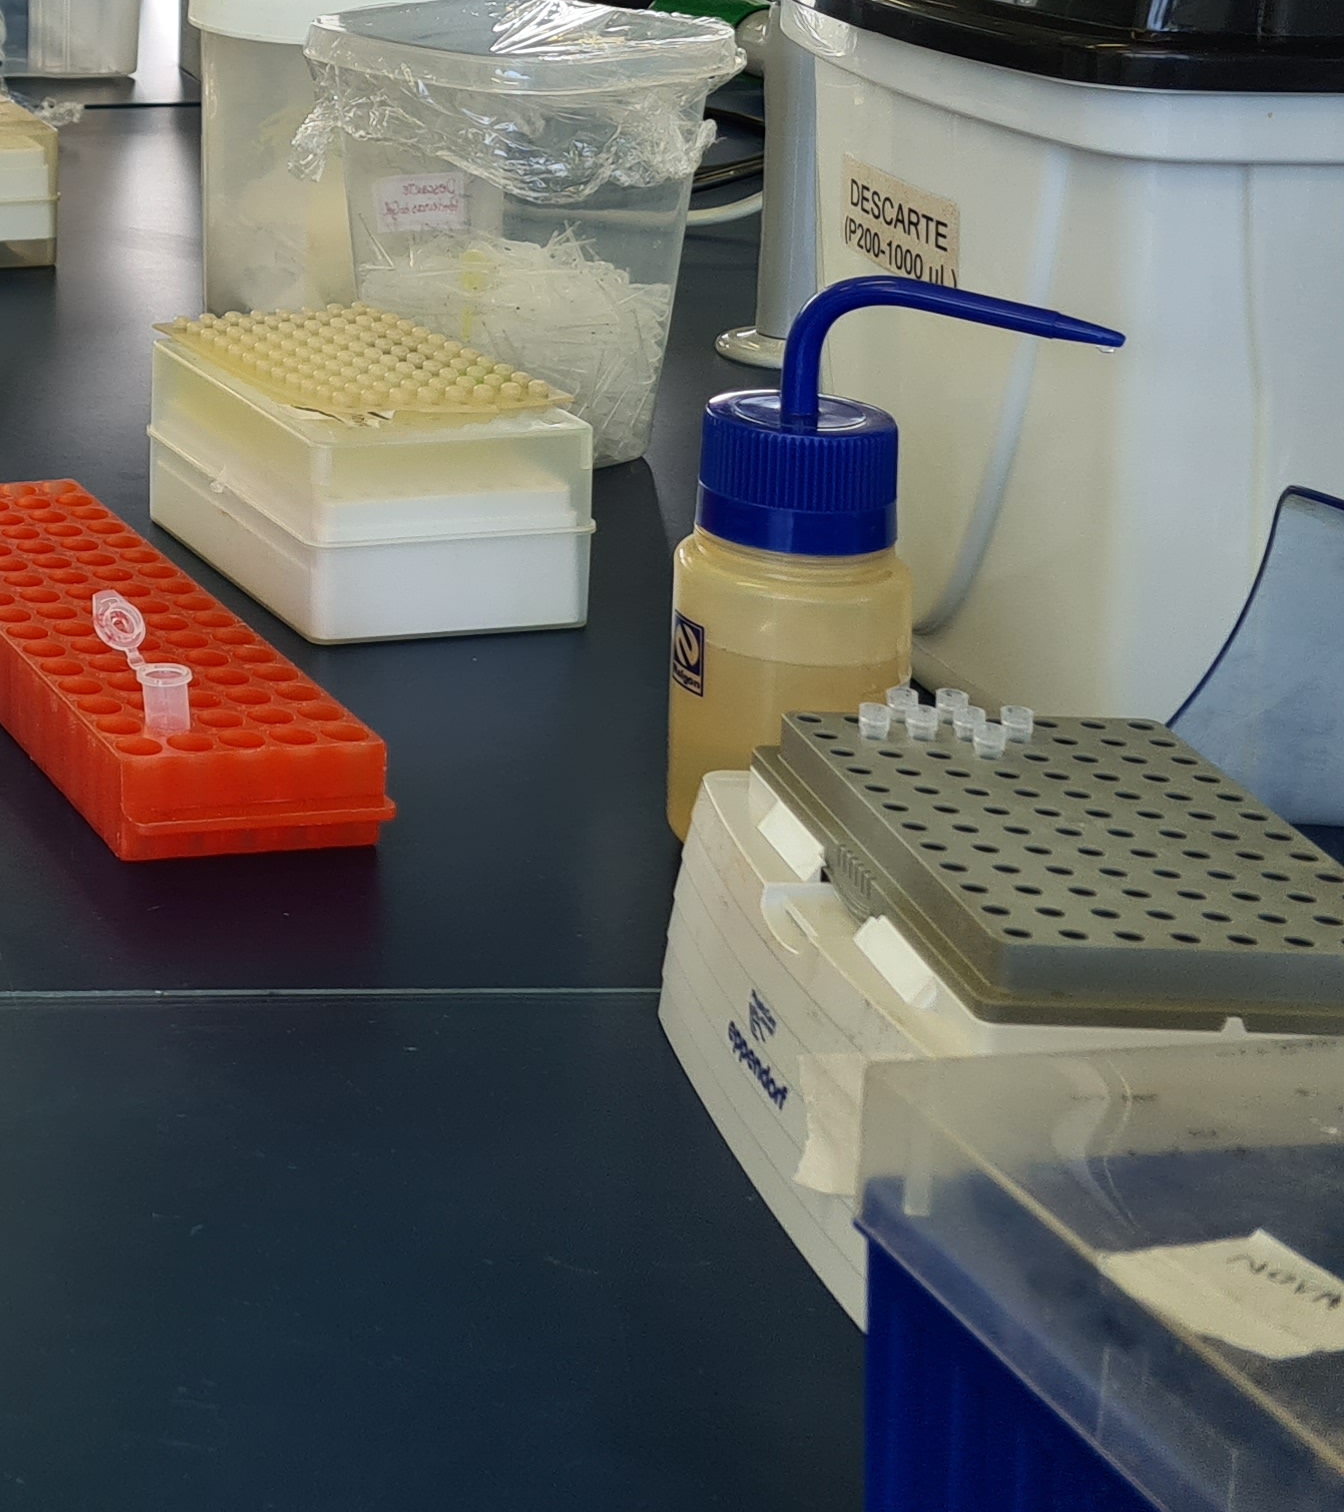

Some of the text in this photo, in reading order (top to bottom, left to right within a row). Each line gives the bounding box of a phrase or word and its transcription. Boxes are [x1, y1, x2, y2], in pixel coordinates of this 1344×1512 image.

[845, 215, 924, 279] (P200-1000
[851, 178, 949, 252] DESCARTE
[728, 1020, 788, 1110] eppendorf
